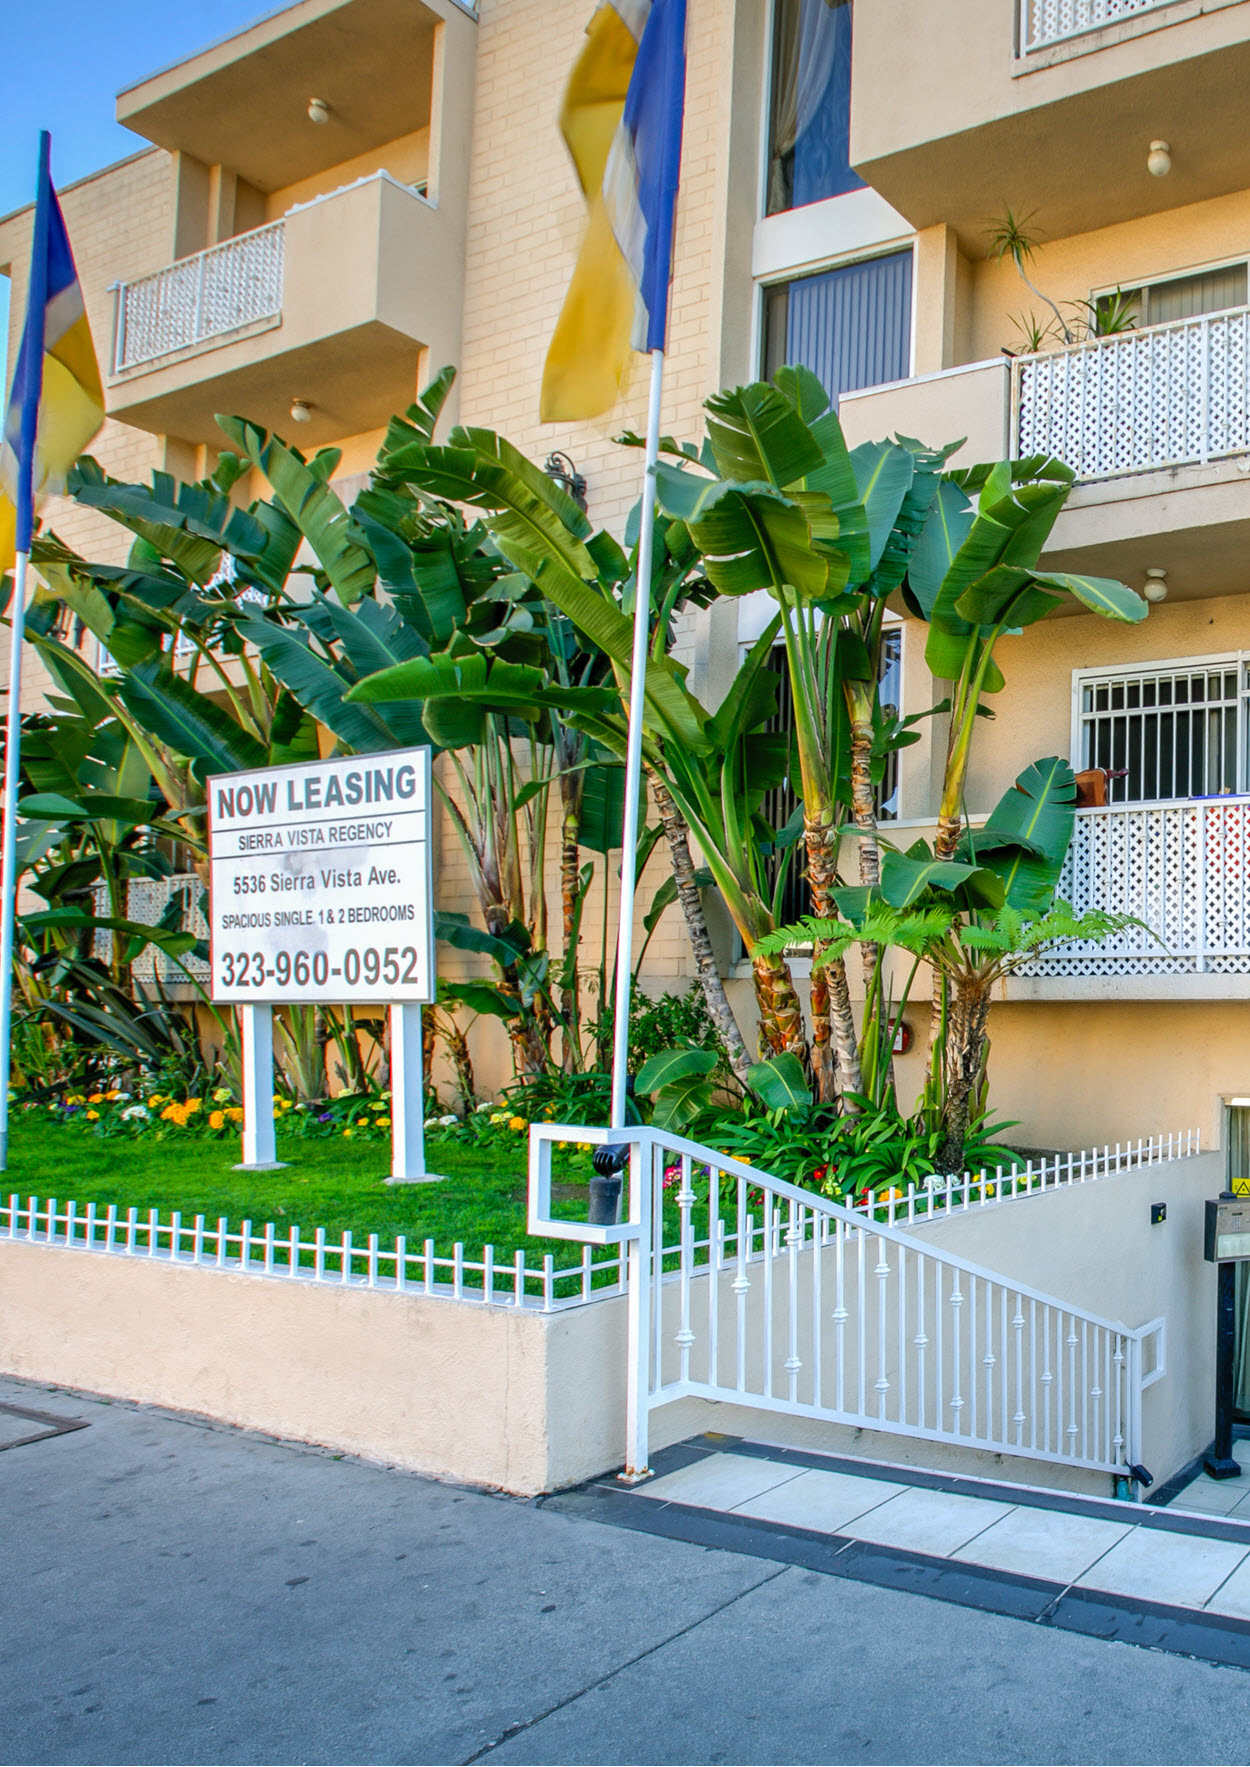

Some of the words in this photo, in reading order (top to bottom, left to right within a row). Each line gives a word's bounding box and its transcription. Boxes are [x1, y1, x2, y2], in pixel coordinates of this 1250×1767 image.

[217, 782, 278, 819] NOW
[287, 765, 417, 811] LEASING
[238, 832, 284, 851] SIERRA
[287, 827, 326, 846] VISTA
[328, 821, 393, 842] REGENCY
[233, 875, 266, 894] 5536
[270, 873, 315, 892] Sierra
[320, 868, 362, 888] Vista
[367, 866, 401, 886] Ave.
[222, 911, 271, 929] SPACIOUS
[318, 909, 325, 925] 1
[326, 909, 336, 925] &
[338, 908, 346, 923] 2
[347, 904, 415, 923] BEDROOMS
[221, 946, 419, 987] 323-960-0952
